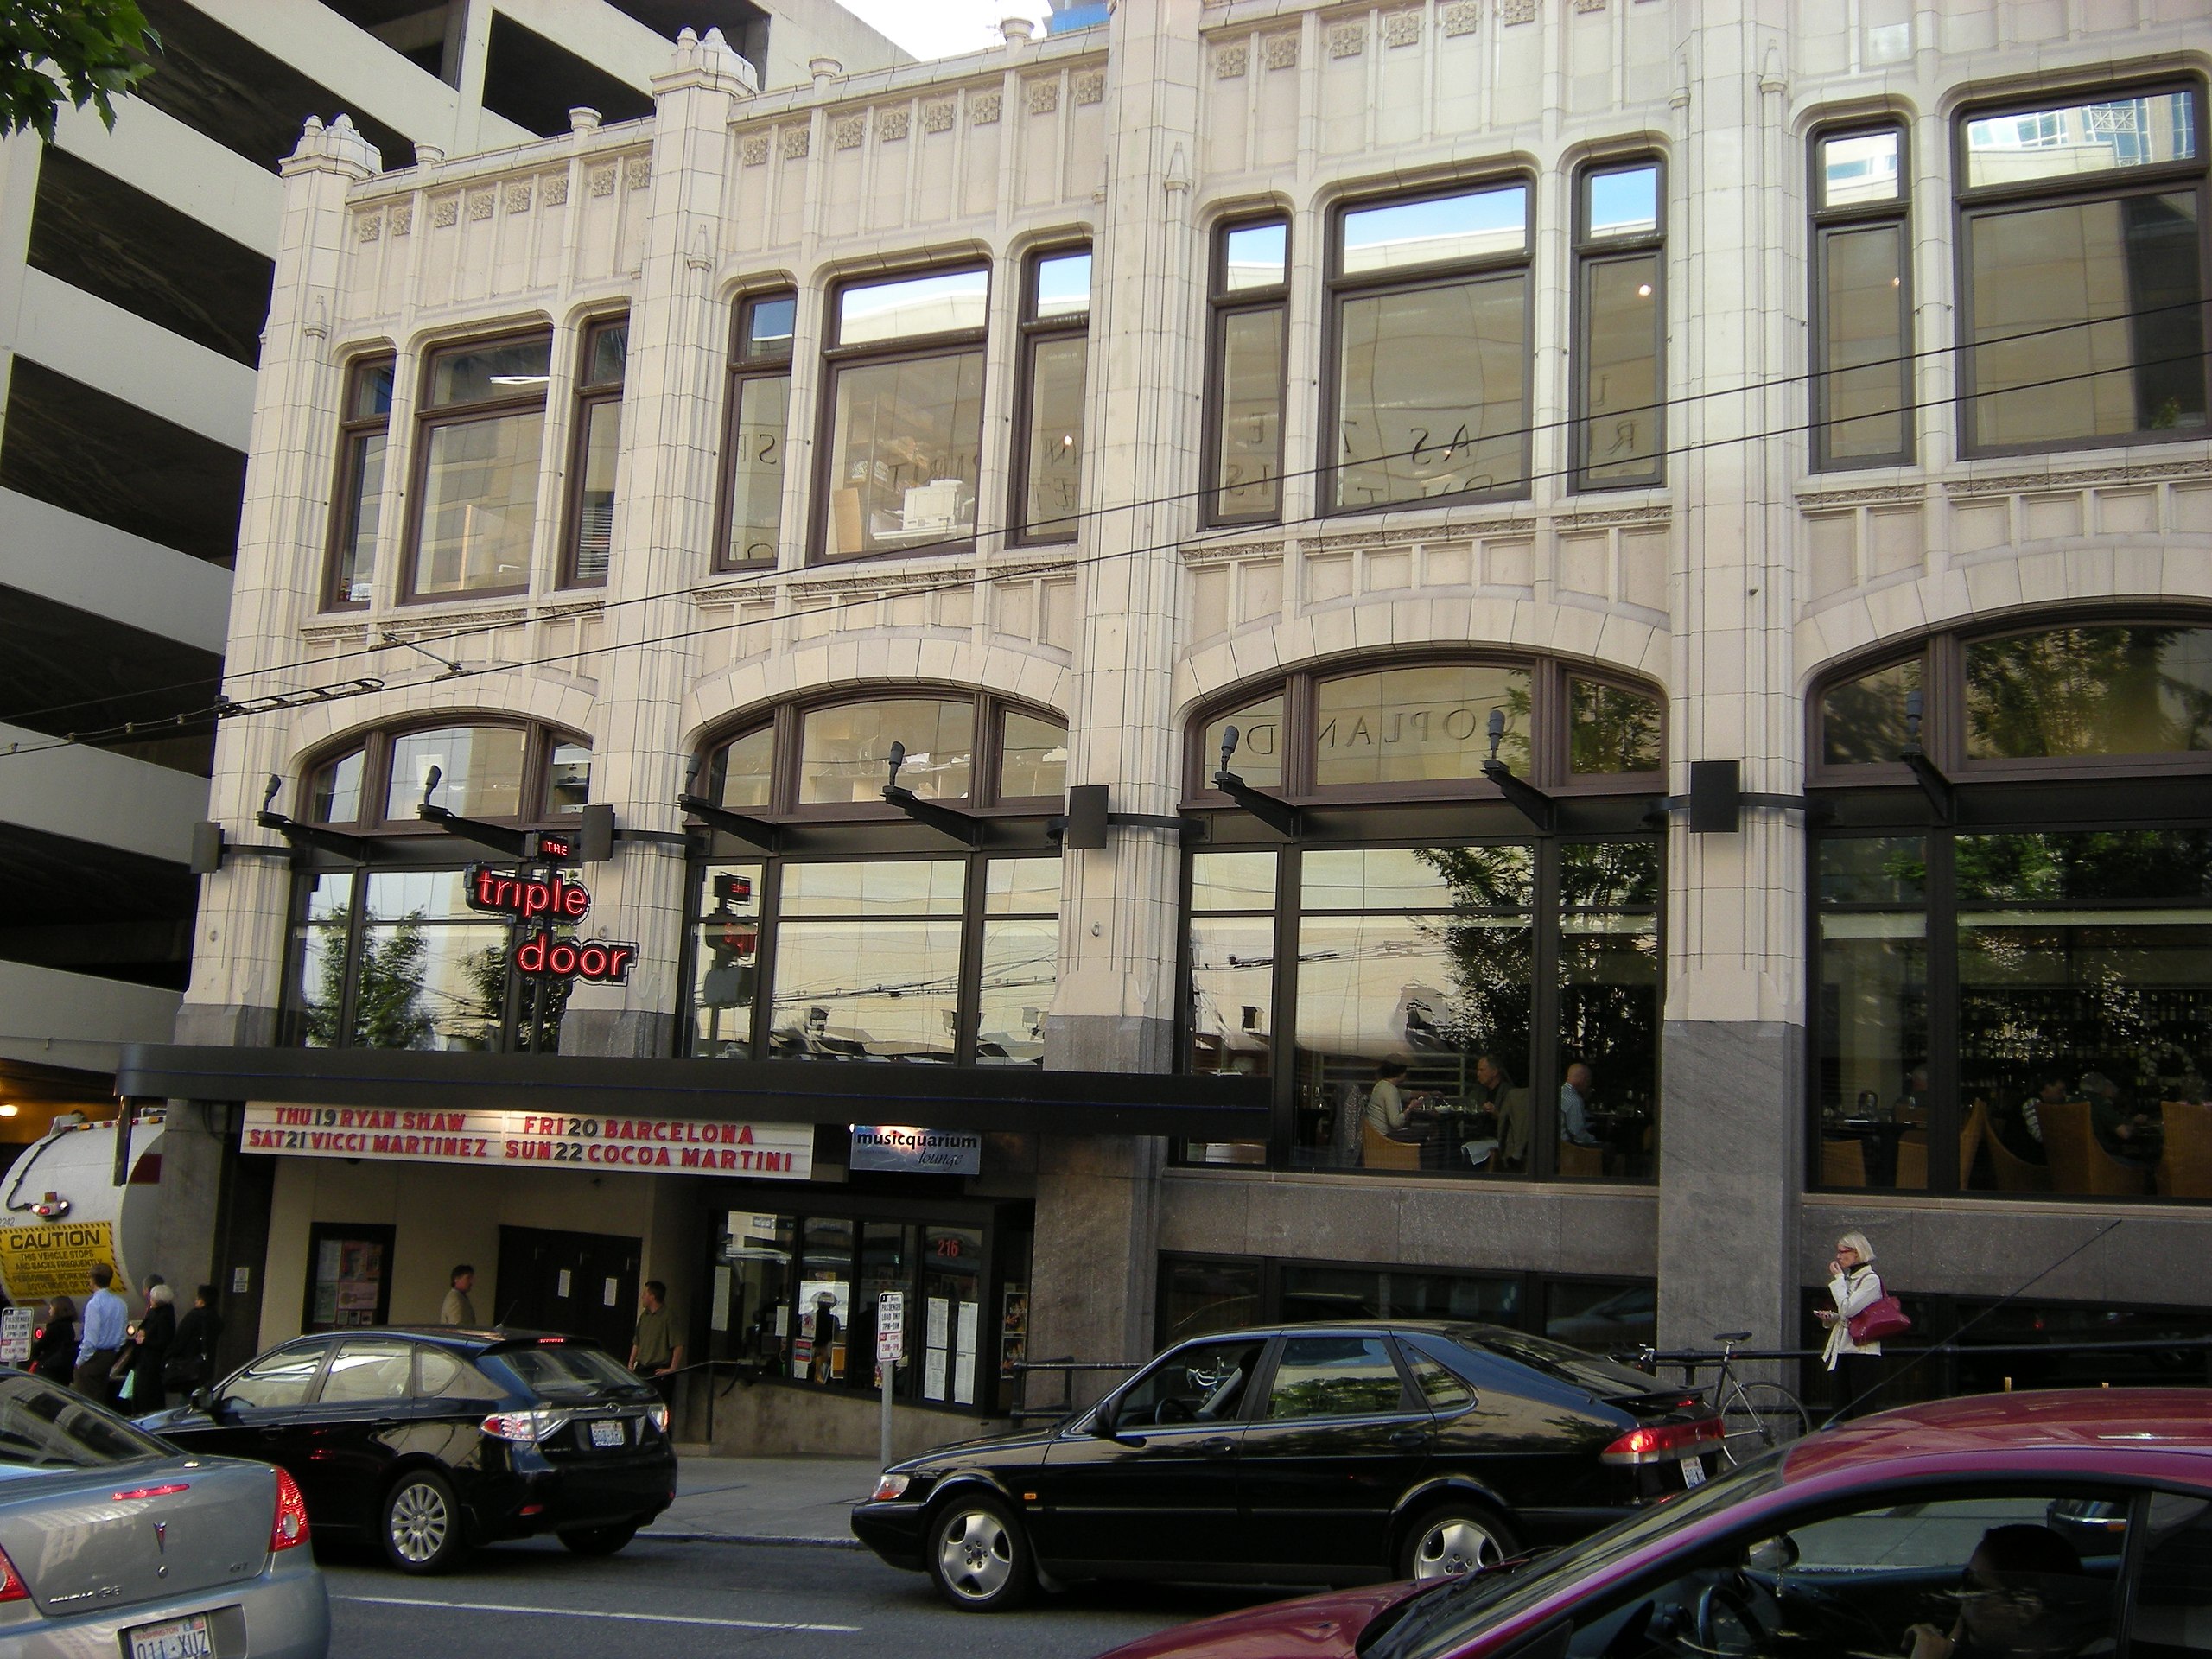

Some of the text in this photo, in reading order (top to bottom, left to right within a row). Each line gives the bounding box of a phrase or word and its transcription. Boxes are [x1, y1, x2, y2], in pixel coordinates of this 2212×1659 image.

[546, 841, 568, 856] THE
[478, 869, 589, 918] triple
[519, 934, 628, 977] door
[276, 1107, 466, 1132] THU 19 RYAN SHAW
[524, 1116, 753, 1145] FRI 20 BARCELONA
[856, 1130, 977, 1150] musicquarium
[249, 1128, 487, 1157] SAT 21 VICCI MARTINEZ
[505, 1140, 792, 1173] SUN 22 COCOA MARTINI
[918, 1147, 964, 1168] lounge
[10, 1229, 100, 1250] CAUTION
[938, 1239, 958, 1258] 216
[22, 1249, 94, 1262] THIS VEHICLE STOPS
[31, 1261, 56, 1271] BACKS
